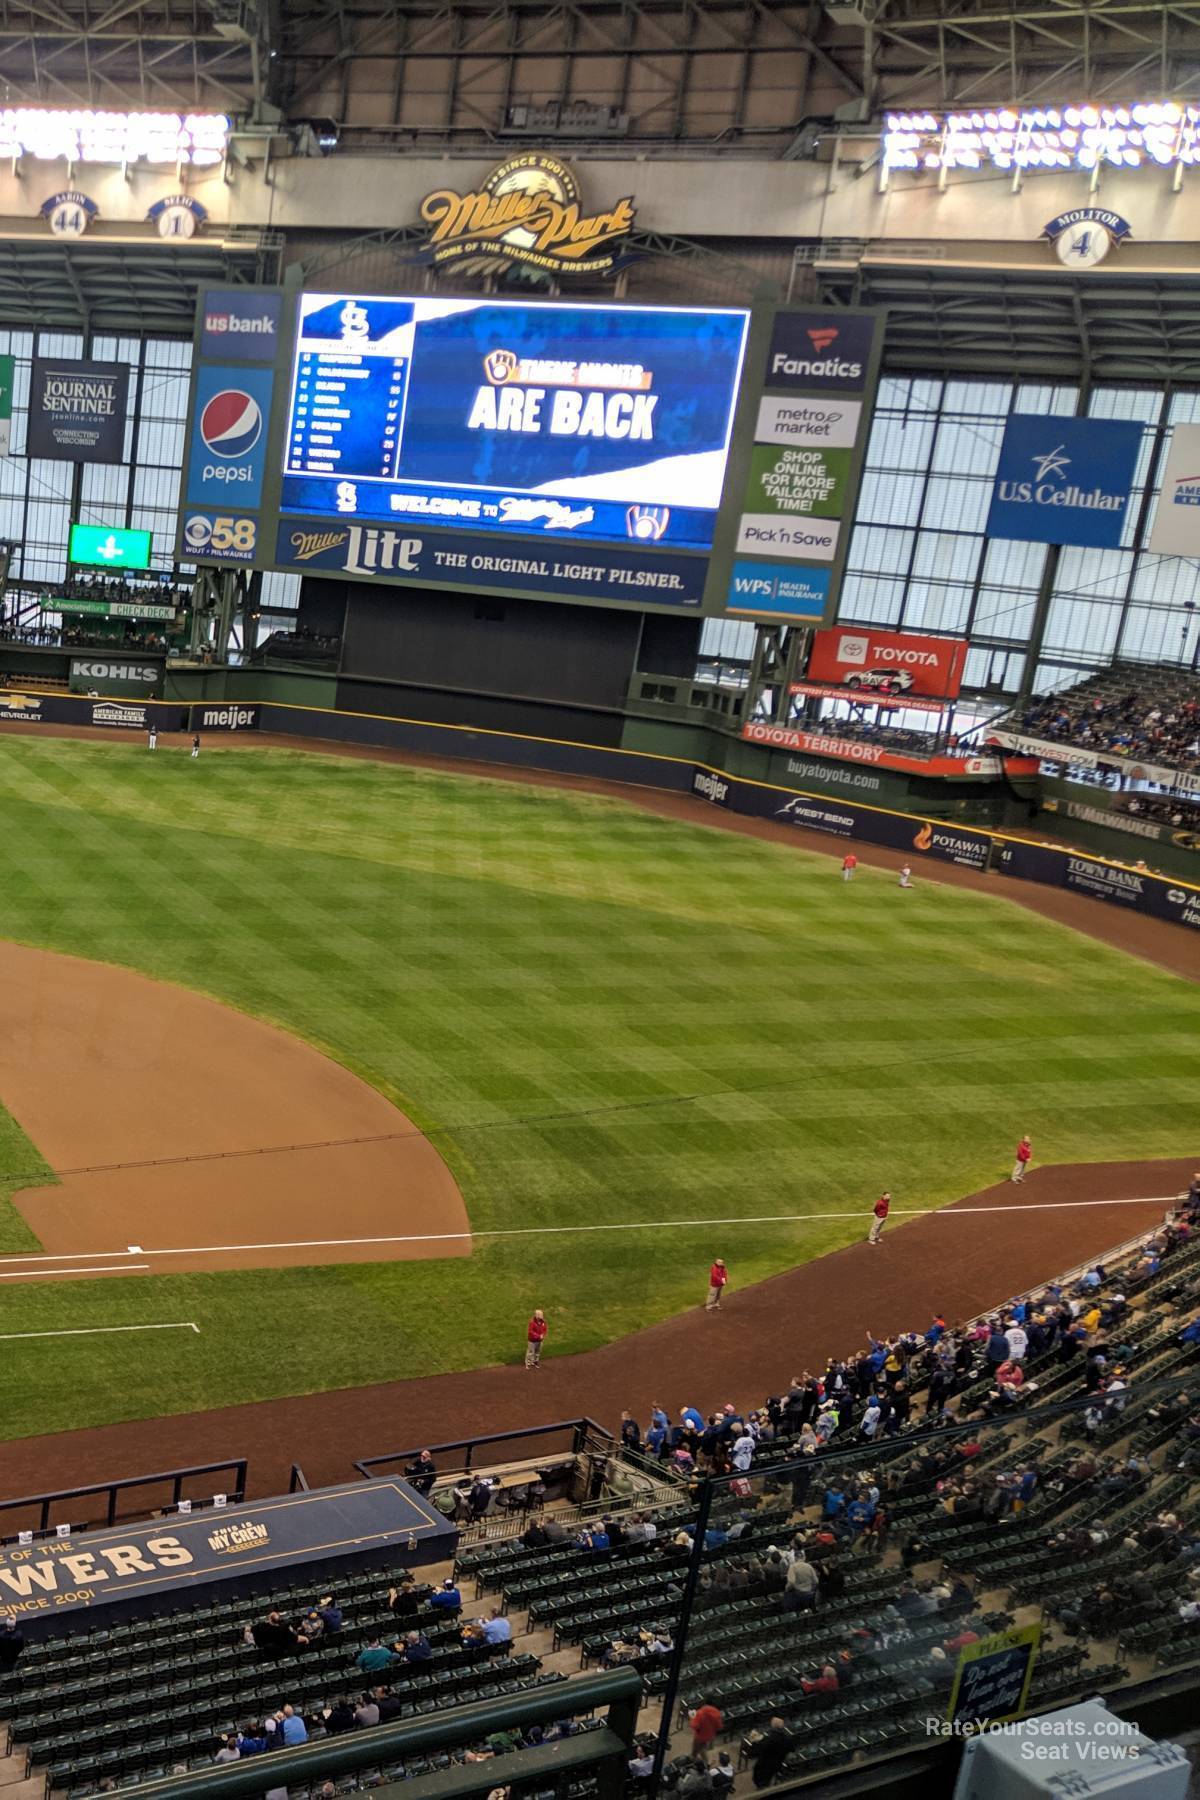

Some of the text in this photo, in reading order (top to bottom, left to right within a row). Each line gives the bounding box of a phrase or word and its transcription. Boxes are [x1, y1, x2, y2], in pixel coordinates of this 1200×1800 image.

[499, 156, 564, 178] SINCE 2001
[55, 192, 85, 204] AARON
[55, 210, 80, 231] 44
[171, 216, 181, 234] 1
[420, 190, 635, 258] Miller Park
[1057, 210, 1120, 227] MOLITOR
[1071, 231, 1093, 258] 4
[435, 242, 613, 272] HOME OF THE MILWAUKEE BREWERS
[772, 353, 862, 378] Fanatics
[44, 381, 116, 400] JOURNAL
[42, 396, 115, 415] SENTINEL
[468, 386, 658, 440] ARE BACK
[777, 408, 826, 421] metro
[53, 429, 100, 439] CONNECTING
[774, 421, 830, 436] market
[56, 437, 96, 446] WISCONSIN
[783, 451, 822, 463] SHOP
[203, 465, 252, 484] pepsi
[774, 462, 827, 477] ONLINE
[761, 473, 836, 489] FOR MORE
[764, 485, 828, 500] TAILGATE
[1035, 484, 1125, 511] Cellular
[390, 494, 498, 517] WELCOME TO
[776, 498, 813, 512] TIME!
[211, 518, 256, 551] 58
[744, 527, 776, 541] Pick
[793, 532, 832, 547] Save
[211, 549, 252, 559] MILWAUKEE
[291, 526, 685, 590] Miller Lite THE ORIGINAL LIGHT PILSNER.
[735, 577, 772, 595] WPS
[779, 589, 823, 600] INSURANCE
[780, 581, 810, 591] HEALTH
[116, 605, 170, 617] CHECK DECK
[873, 646, 939, 666] TOYOTA
[73, 662, 158, 682] KOHL'S
[791, 686, 822, 695] COURTESY
[850, 693, 887, 703] WISCONSIN
[887, 698, 910, 707] TOYOTA
[912, 702, 941, 711] DEALERS
[203, 706, 255, 729] meijer
[746, 725, 883, 762] TOYOTA TERRITORY
[787, 759, 880, 790] buyatoyota.com
[694, 773, 728, 800] meijer
[795, 806, 854, 826] WEST BEND
[1069, 858, 1144, 892] TOWN BANK
[208, 1524, 268, 1550] MY CREW
[212, 1525, 238, 1536] THIS
[10, 1549, 33, 1561] OF
[37, 1542, 74, 1556] THE
[56, 1589, 95, 1606] 2001
[979, 1634, 1023, 1656] PLEASE
[964, 1653, 1012, 1687] Do not
